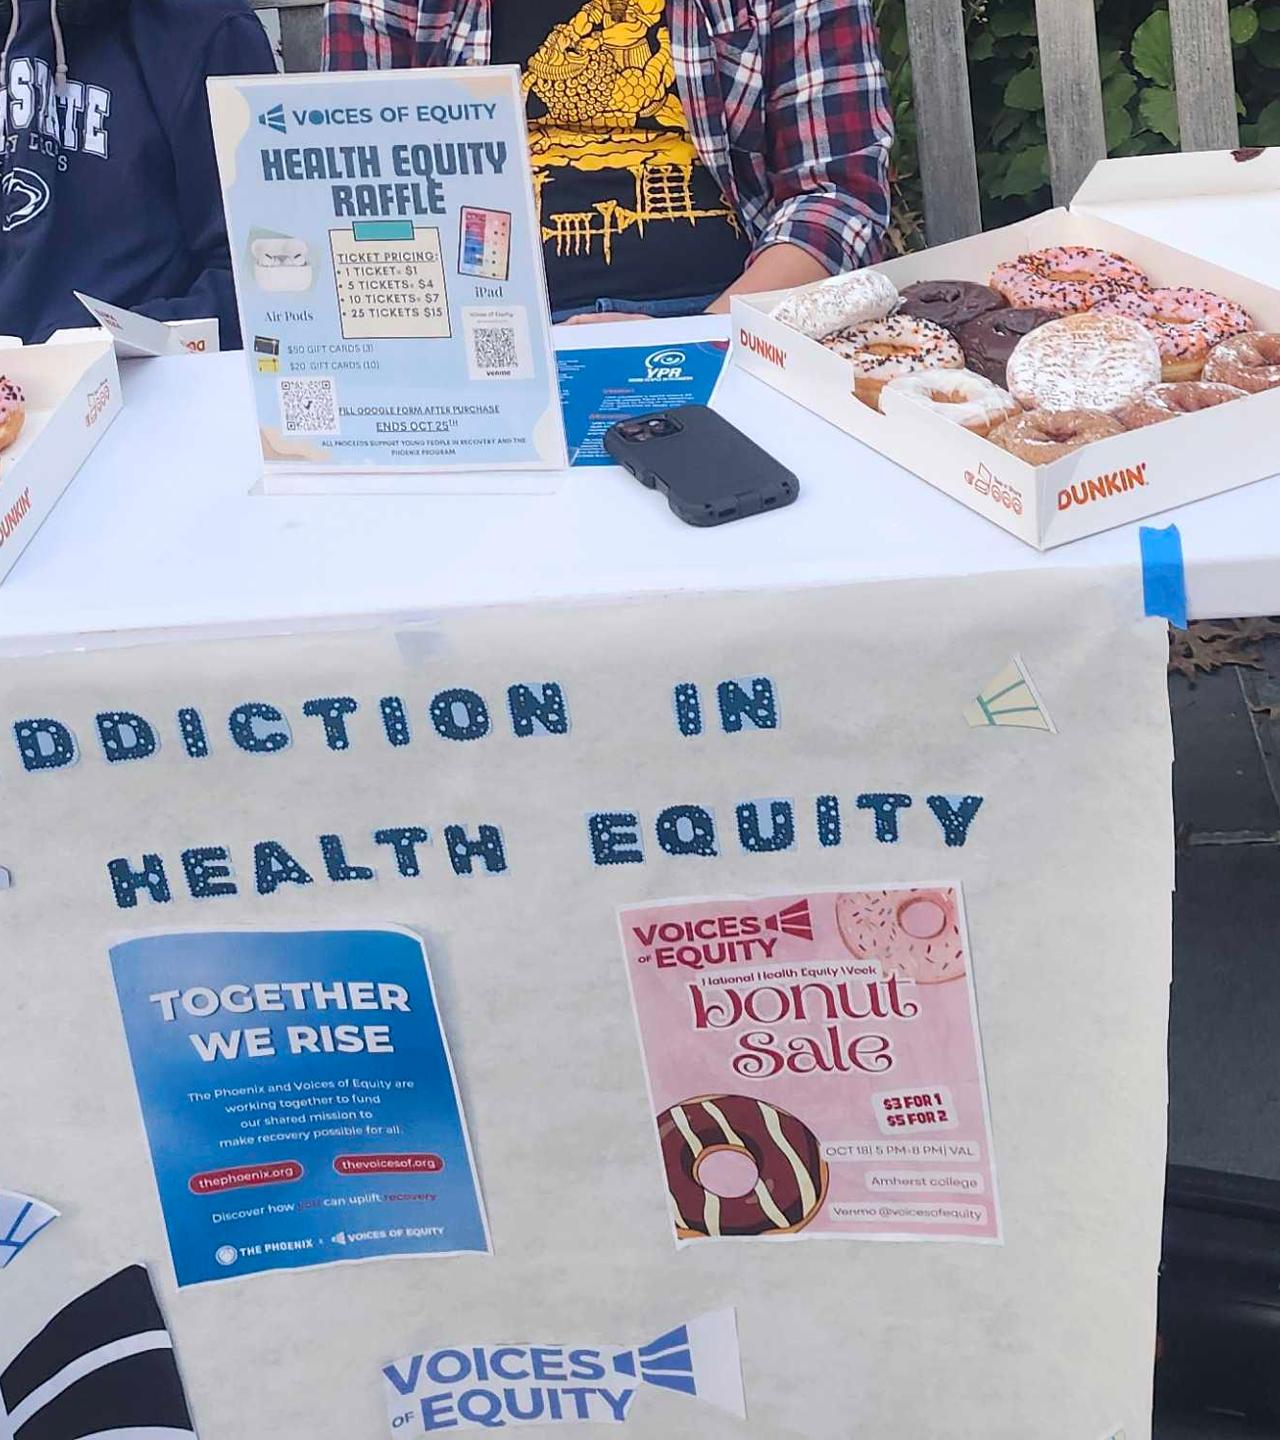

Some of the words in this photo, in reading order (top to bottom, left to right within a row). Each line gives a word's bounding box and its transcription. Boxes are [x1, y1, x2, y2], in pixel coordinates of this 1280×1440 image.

[292, 107, 373, 126] VOICES
[380, 106, 410, 123] OF
[417, 103, 497, 124] EQUITY
[260, 145, 381, 181] HEALTH
[392, 141, 508, 180] EQUITY
[332, 180, 446, 217] RAFFLE
[336, 252, 380, 263] TICKET
[384, 251, 439, 263] PRICING:
[348, 281, 355, 290] 5
[418, 279, 434, 290] $4
[475, 286, 504, 298] iPad
[350, 296, 361, 304] 10
[424, 293, 440, 303] $7
[285, 310, 314, 322] Pods
[351, 309, 365, 318] 25
[369, 308, 420, 318] TICKETS
[423, 307, 443, 318] $15
[287, 345, 305, 355] $50
[307, 345, 327, 354] GIFT
[329, 344, 361, 353] CARDS
[740, 327, 787, 368] DUNKIN'
[290, 361, 306, 371] $20
[310, 361, 329, 370] GIFT
[331, 361, 361, 370] CARDS
[362, 360, 380, 370] (10)
[647, 367, 682, 379] YPR
[376, 422, 407, 432] ENDS
[410, 421, 431, 432] OCT
[1057, 463, 1147, 510] DUNKIN'
[0, 487, 31, 547] DUNKIN'
[673, 677, 777, 737] IN
[107, 824, 508, 908] HEALTH
[587, 792, 984, 866] EQUITY
[633, 917, 761, 946] VOICES
[638, 955, 652, 964] OF
[656, 938, 778, 970] EQUITY
[701, 973, 754, 986] National
[757, 969, 798, 980] Health
[801, 966, 838, 977] Equity
[841, 965, 877, 975] Week
[149, 981, 412, 1022] TOGETHER
[189, 1026, 275, 1063] WE
[286, 1024, 394, 1055] RISE
[732, 1025, 893, 1078] Sale
[187, 1091, 211, 1104] The
[213, 1084, 265, 1101] Phoenix
[268, 1082, 291, 1094] and
[293, 1078, 335, 1092] Voices
[338, 1078, 350, 1089] of
[352, 1078, 391, 1091] Equity
[394, 1079, 414, 1089] are
[883, 1097, 902, 1110] $3
[903, 1094, 932, 1109] FOR
[934, 1093, 943, 1106] 1
[225, 1099, 277, 1115] working
[279, 1095, 334, 1111] together
[336, 1095, 349, 1104] to
[351, 1093, 381, 1104] fund
[240, 1118, 261, 1129] our
[264, 1114, 307, 1126] shared
[309, 1111, 356, 1122] mission
[359, 1110, 373, 1120] to
[887, 1113, 906, 1127] $5
[908, 1112, 935, 1126] FOR
[937, 1110, 949, 1122] 2
[219, 1135, 254, 1148] make
[257, 1130, 310, 1145] recovery
[313, 1125, 364, 1139] possible
[365, 1124, 383, 1135] for
[825, 1147, 854, 1157] OCT
[875, 1146, 883, 1155] 5
[949, 1146, 975, 1156] VAL
[199, 1166, 293, 1188] thephoenix.org
[342, 1158, 435, 1171] thevoicesof.org
[872, 1176, 926, 1187] Amherst
[930, 1178, 978, 1189] college
[212, 1208, 264, 1224] Discover
[268, 1202, 295, 1213] how
[324, 1197, 346, 1207] can
[349, 1193, 382, 1206] uplift
[383, 1192, 437, 1202] recovery
[833, 1207, 876, 1217] Venmo
[878, 1206, 982, 1220] @voicesofequity
[239, 1246, 262, 1257] THE
[264, 1239, 313, 1253] PHOENIX
[348, 1231, 386, 1242] VOICES
[389, 1229, 403, 1238] OF
[406, 1226, 445, 1237] EQUITY
[383, 1347, 605, 1395] VOICES
[392, 1411, 415, 1429] OF
[420, 1386, 637, 1432] EQUITY
